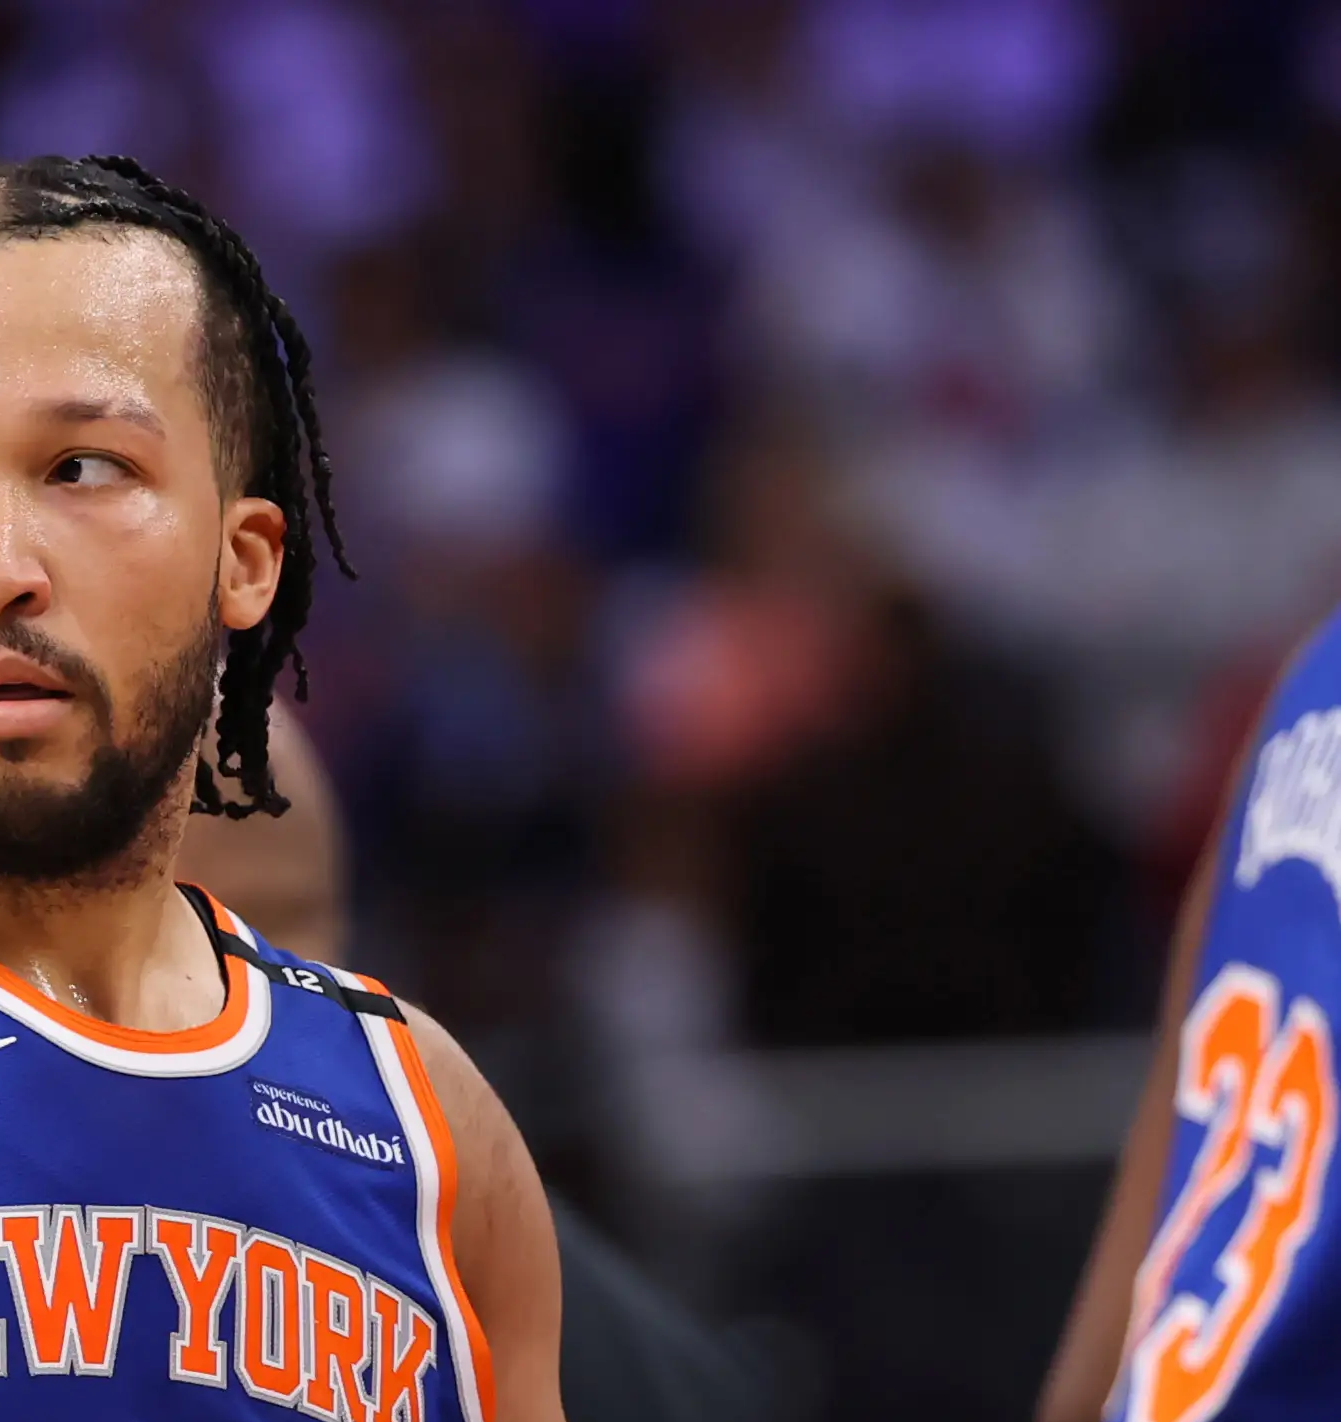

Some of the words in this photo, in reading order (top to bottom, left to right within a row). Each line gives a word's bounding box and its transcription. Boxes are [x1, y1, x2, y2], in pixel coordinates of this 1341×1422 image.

[281, 967, 324, 993] 12
[253, 1080, 331, 1114] experience
[257, 1102, 314, 1140] abu
[317, 1117, 405, 1165] dhabi
